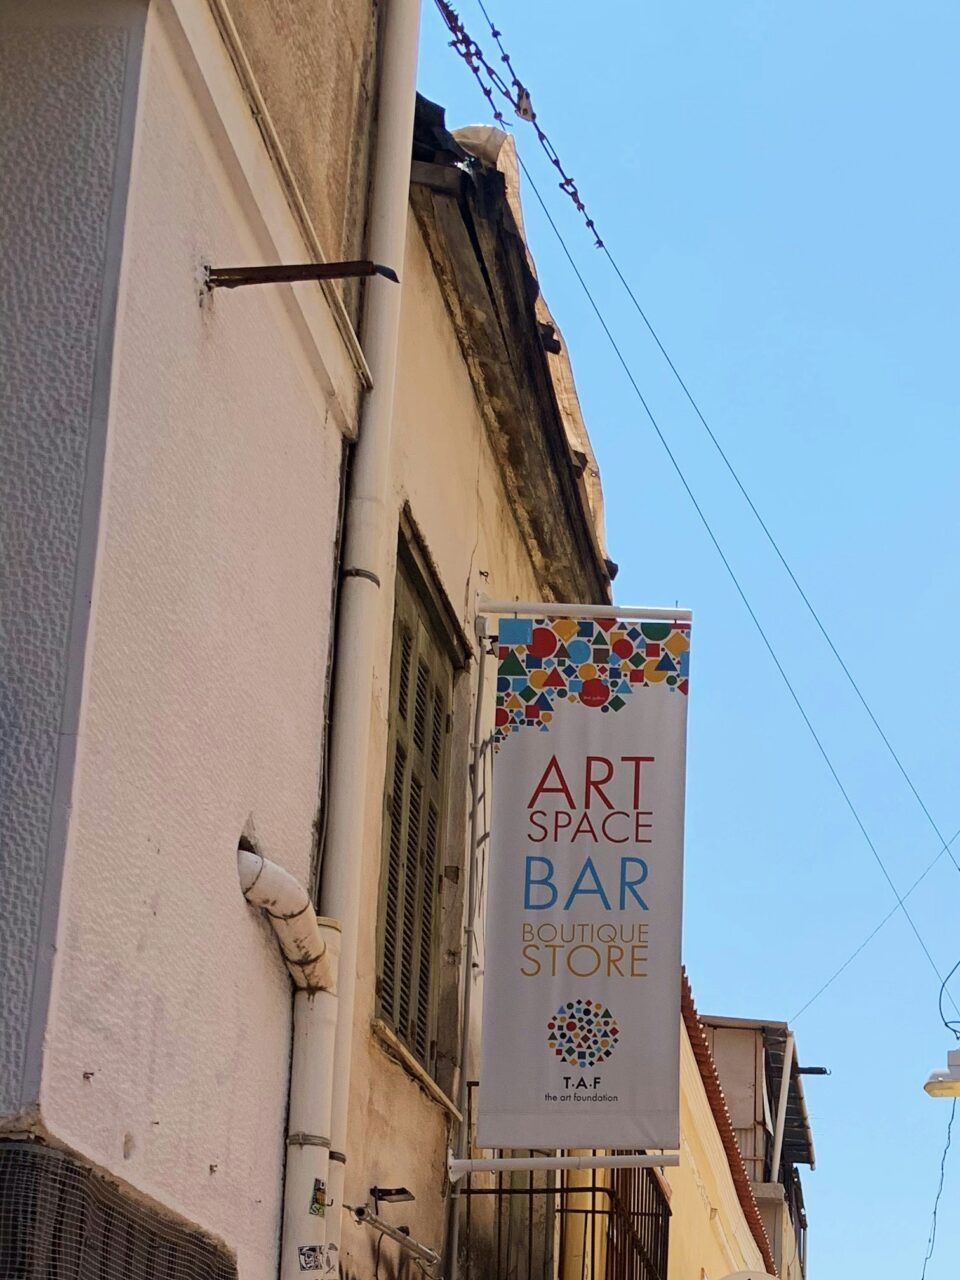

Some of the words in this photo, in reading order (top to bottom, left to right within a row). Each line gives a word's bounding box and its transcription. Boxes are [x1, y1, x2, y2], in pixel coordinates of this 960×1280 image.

[527, 754, 655, 810] ART
[527, 810, 653, 844] SPACE
[523, 855, 650, 911] BAR
[522, 923, 649, 943] BOUTIQUE
[520, 944, 649, 978] STORE
[544, 1092, 558, 1102] the
[560, 1093, 572, 1102] art
[573, 1092, 619, 1102] foundation
